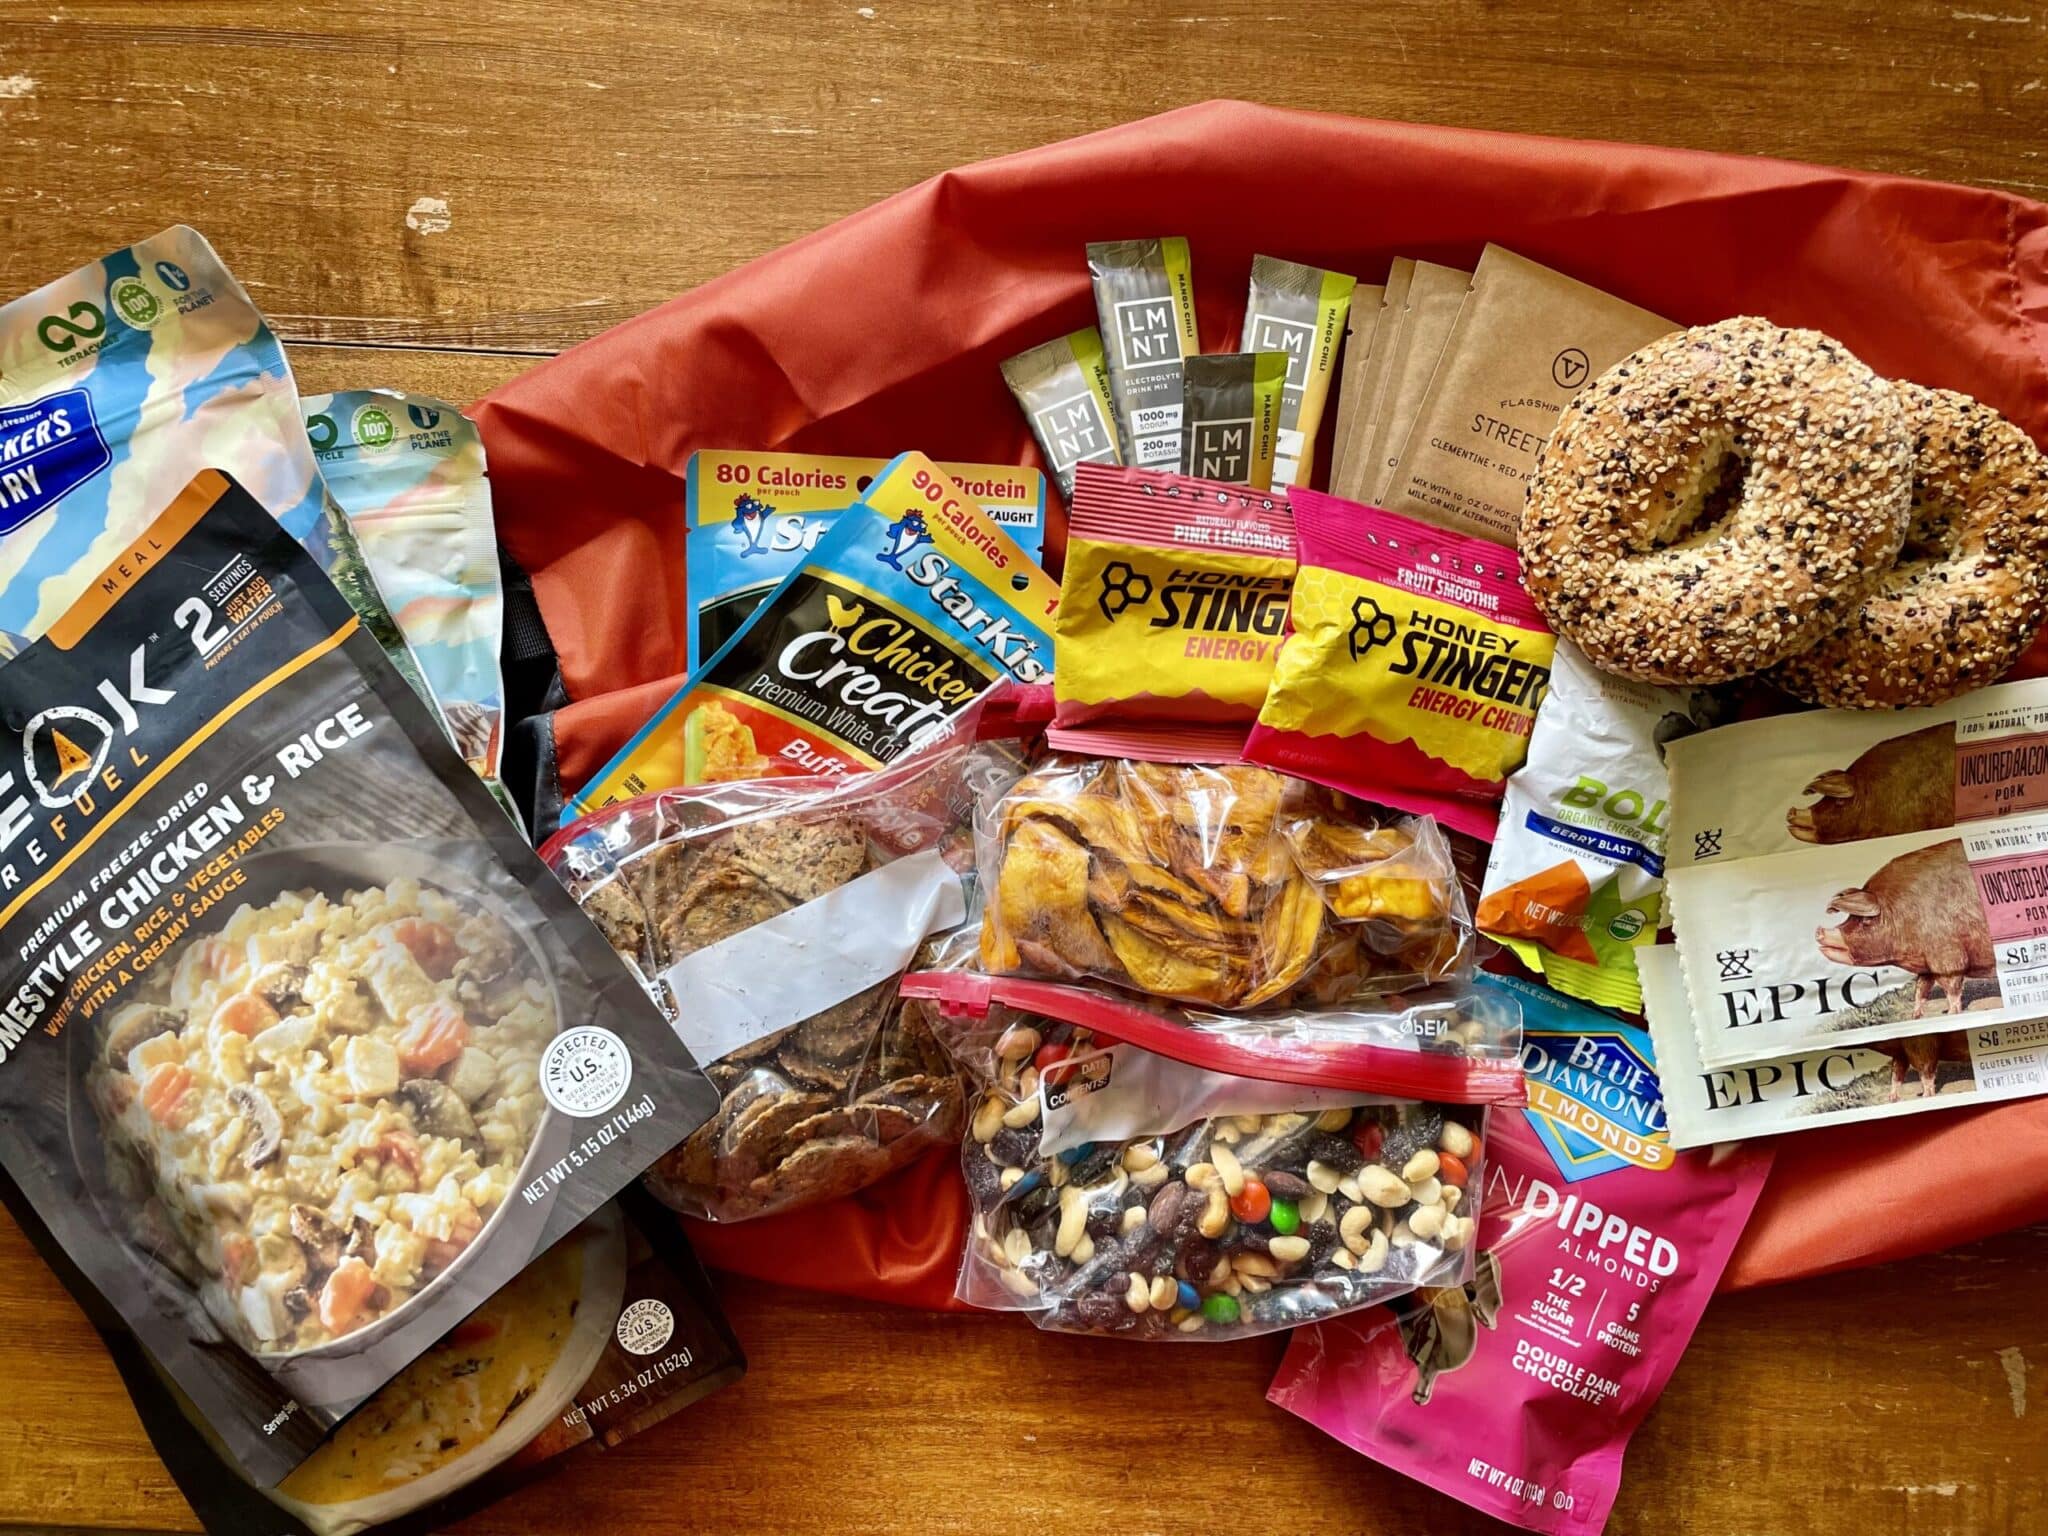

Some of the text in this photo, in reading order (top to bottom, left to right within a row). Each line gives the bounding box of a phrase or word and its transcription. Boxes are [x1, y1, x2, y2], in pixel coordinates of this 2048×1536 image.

[177, 294, 216, 316] PLANET
[1127, 306, 1168, 333] LM
[1178, 273, 1193, 338] MANGO CHILI
[57, 333, 121, 369] TERRACYCLE
[1132, 332, 1169, 359] NT
[1262, 326, 1304, 354] LM
[1319, 307, 1336, 372] MANGO CHILI
[1093, 365, 1110, 399] MANGO
[1125, 371, 1181, 387] ELECTROLYTE
[1126, 382, 1168, 396] DRINK MIX
[1049, 402, 1091, 436] LM
[1138, 410, 1178, 422] 1000 mg
[1500, 397, 1560, 414] FLAGSHIP
[409, 430, 450, 442] FOR THE
[1140, 420, 1169, 430] SODIUM
[1203, 428, 1243, 453] LM
[1260, 394, 1272, 461] MANGO CHILI
[1471, 413, 1548, 457] STREET
[411, 438, 452, 451] PLANET
[1059, 426, 1096, 459] NT
[1142, 440, 1177, 451] 200 mg
[1431, 437, 1518, 478] CLEMENTINE RED
[716, 464, 848, 490] 80 Calories
[757, 488, 801, 497] per pouch
[1412, 476, 1428, 489] MIX
[1430, 482, 1451, 497] WITH
[1453, 491, 1463, 502] 10
[1467, 498, 1481, 509] OZ
[1494, 508, 1510, 519] HOT
[1443, 501, 1462, 514] MILK
[912, 469, 1010, 569] 90 Calories
[932, 512, 967, 546] per pouch
[986, 509, 1035, 524] CAUGHT
[1196, 515, 1271, 533] NATURALLY FLAVORED
[1174, 524, 1291, 551] PINK LEMONADE
[102, 538, 162, 595] MEAL
[208, 559, 253, 603] SERVINGS
[1168, 568, 1294, 590] HONEY
[1415, 562, 1482, 589] NATURALLY FLAVORED
[225, 575, 267, 618] JUST ADD
[229, 583, 273, 625] WATER
[1397, 567, 1436, 593] FRUIT
[1435, 578, 1500, 612] SMOOTHIE
[173, 596, 230, 658] 2
[204, 647, 233, 672] PREPARE
[238, 626, 250, 641] EAT
[258, 601, 284, 624] POUCH
[1408, 610, 1521, 654] HONEY
[1184, 635, 1272, 662] ENERGY
[1388, 630, 1552, 710] STINGER
[749, 673, 876, 748] Premium White
[1407, 686, 1536, 738] ENERGY CHEWS
[1986, 709, 2009, 717] MADE
[1962, 722, 1985, 735] 100%
[1960, 749, 2014, 787] UNCURED
[1994, 783, 2025, 802] PORK
[0, 746, 150, 891] REFUEL
[100, 702, 375, 931] CHICKEN & RICE
[1556, 809, 1649, 842] ORGANIC ENERGY
[1990, 828, 2010, 836] MADE
[1548, 840, 1594, 861] NATURALLY
[1550, 825, 1597, 846] BERRY
[1598, 839, 1634, 857] BLAST
[1970, 839, 1993, 853] 100%
[19, 782, 209, 962] PREMIUM FREEZE-DRIED
[1980, 868, 2036, 906] UNCURED
[43, 807, 287, 1038] WHITE CHICKEN, RICE, & VEGETABLES
[1524, 900, 1549, 920] NET
[80, 868, 248, 1019] WITH A CREAMY SAUCE
[2006, 946, 2030, 966] 8G
[2006, 973, 2038, 988] GLUTEN
[1537, 991, 1569, 1010] ZIPPER
[1717, 969, 1880, 1030] EPIC
[1978, 1030, 2000, 1049] 8G
[549, 1035, 608, 1082] INSPECTED
[569, 1057, 603, 1083] U.S.
[1567, 1035, 1650, 1096] BLUE
[1980, 1054, 2035, 1071] GLUTEN FREE
[1519, 1042, 1669, 1132] DIAMOND
[1699, 1052, 1857, 1111] EPIC
[521, 1094, 657, 1205] NET WT 5.15 OZ (146g)
[1523, 1178, 1680, 1278] DIPPED
[1548, 1267, 1587, 1297] 1/2
[1557, 1237, 1661, 1294] ALMONDS
[1530, 1299, 1575, 1328] SUGAR
[1546, 1291, 1571, 1312] THE
[1626, 1302, 1640, 1322] 5
[618, 1301, 668, 1340] INSPECTED
[634, 1318, 657, 1336] U.S.
[1606, 1321, 1640, 1344] GRAMS
[1511, 1354, 1606, 1406] CHOCOLATE
[1516, 1338, 1622, 1398] DOUBLE DARK
[562, 1346, 694, 1428] NET WT 5.36 OZ (152g)
[1467, 1457, 1546, 1507] NET WT 4 OZ (113g)
